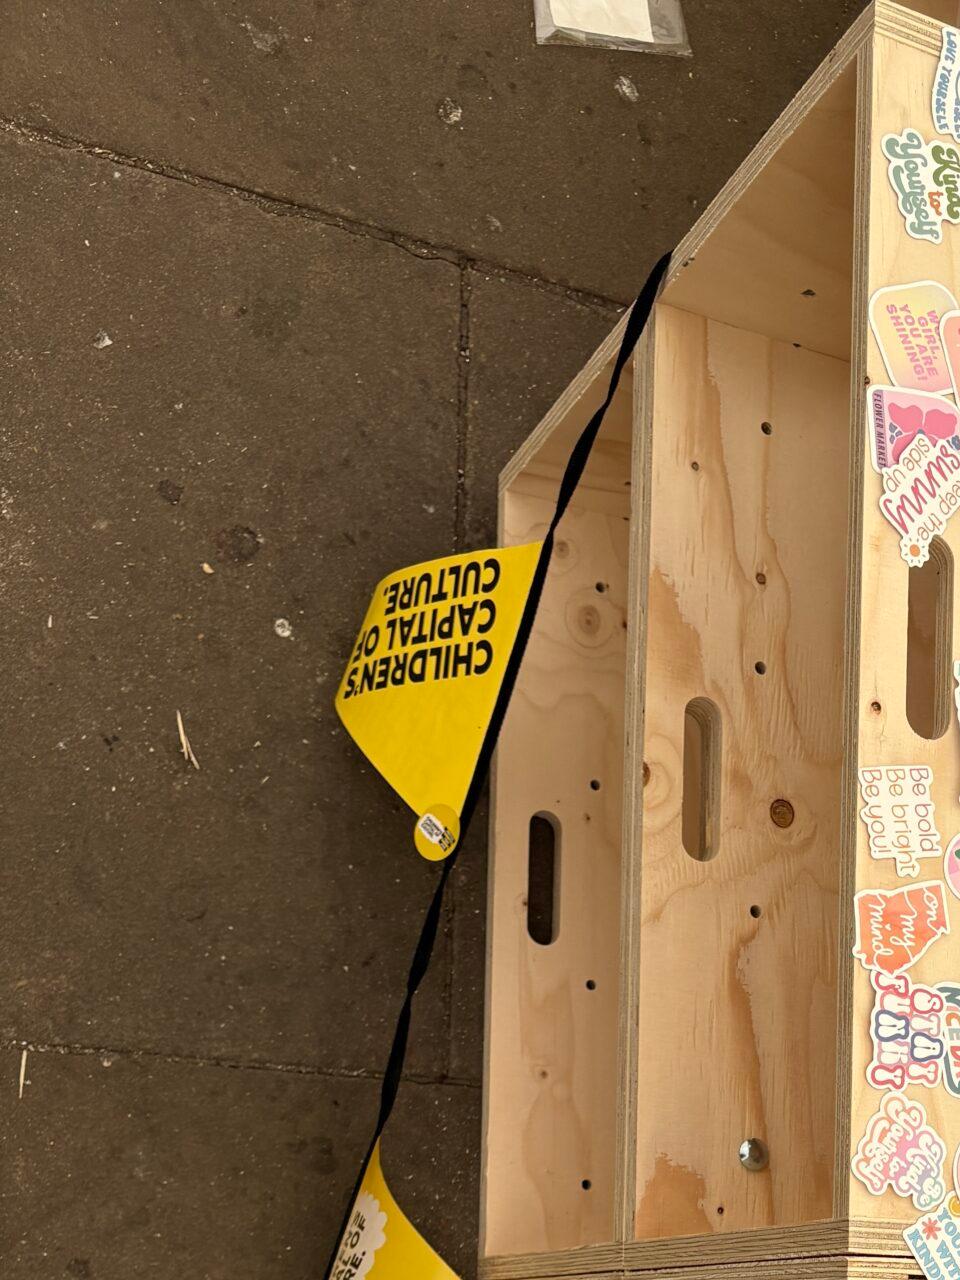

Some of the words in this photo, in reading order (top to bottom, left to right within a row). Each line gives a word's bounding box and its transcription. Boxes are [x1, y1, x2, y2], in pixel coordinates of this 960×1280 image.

[885, 133, 939, 239] Yourself
[887, 304, 928, 381] SHINING!
[873, 394, 885, 429] FLOWER
[876, 431, 887, 469] MARKET
[383, 558, 501, 615] CULTURE.
[387, 599, 496, 650] CAPITAL
[343, 640, 494, 699] CHILDREN'S
[862, 769, 883, 798] Be
[886, 769, 905, 796] Be
[910, 768, 929, 796] Be
[864, 805, 889, 854] you!
[892, 804, 916, 872] bright
[915, 803, 938, 852] bold
[871, 972, 911, 1089] FUNKY
[908, 989, 943, 1084] STAY
[857, 1096, 923, 1192] Yourself
